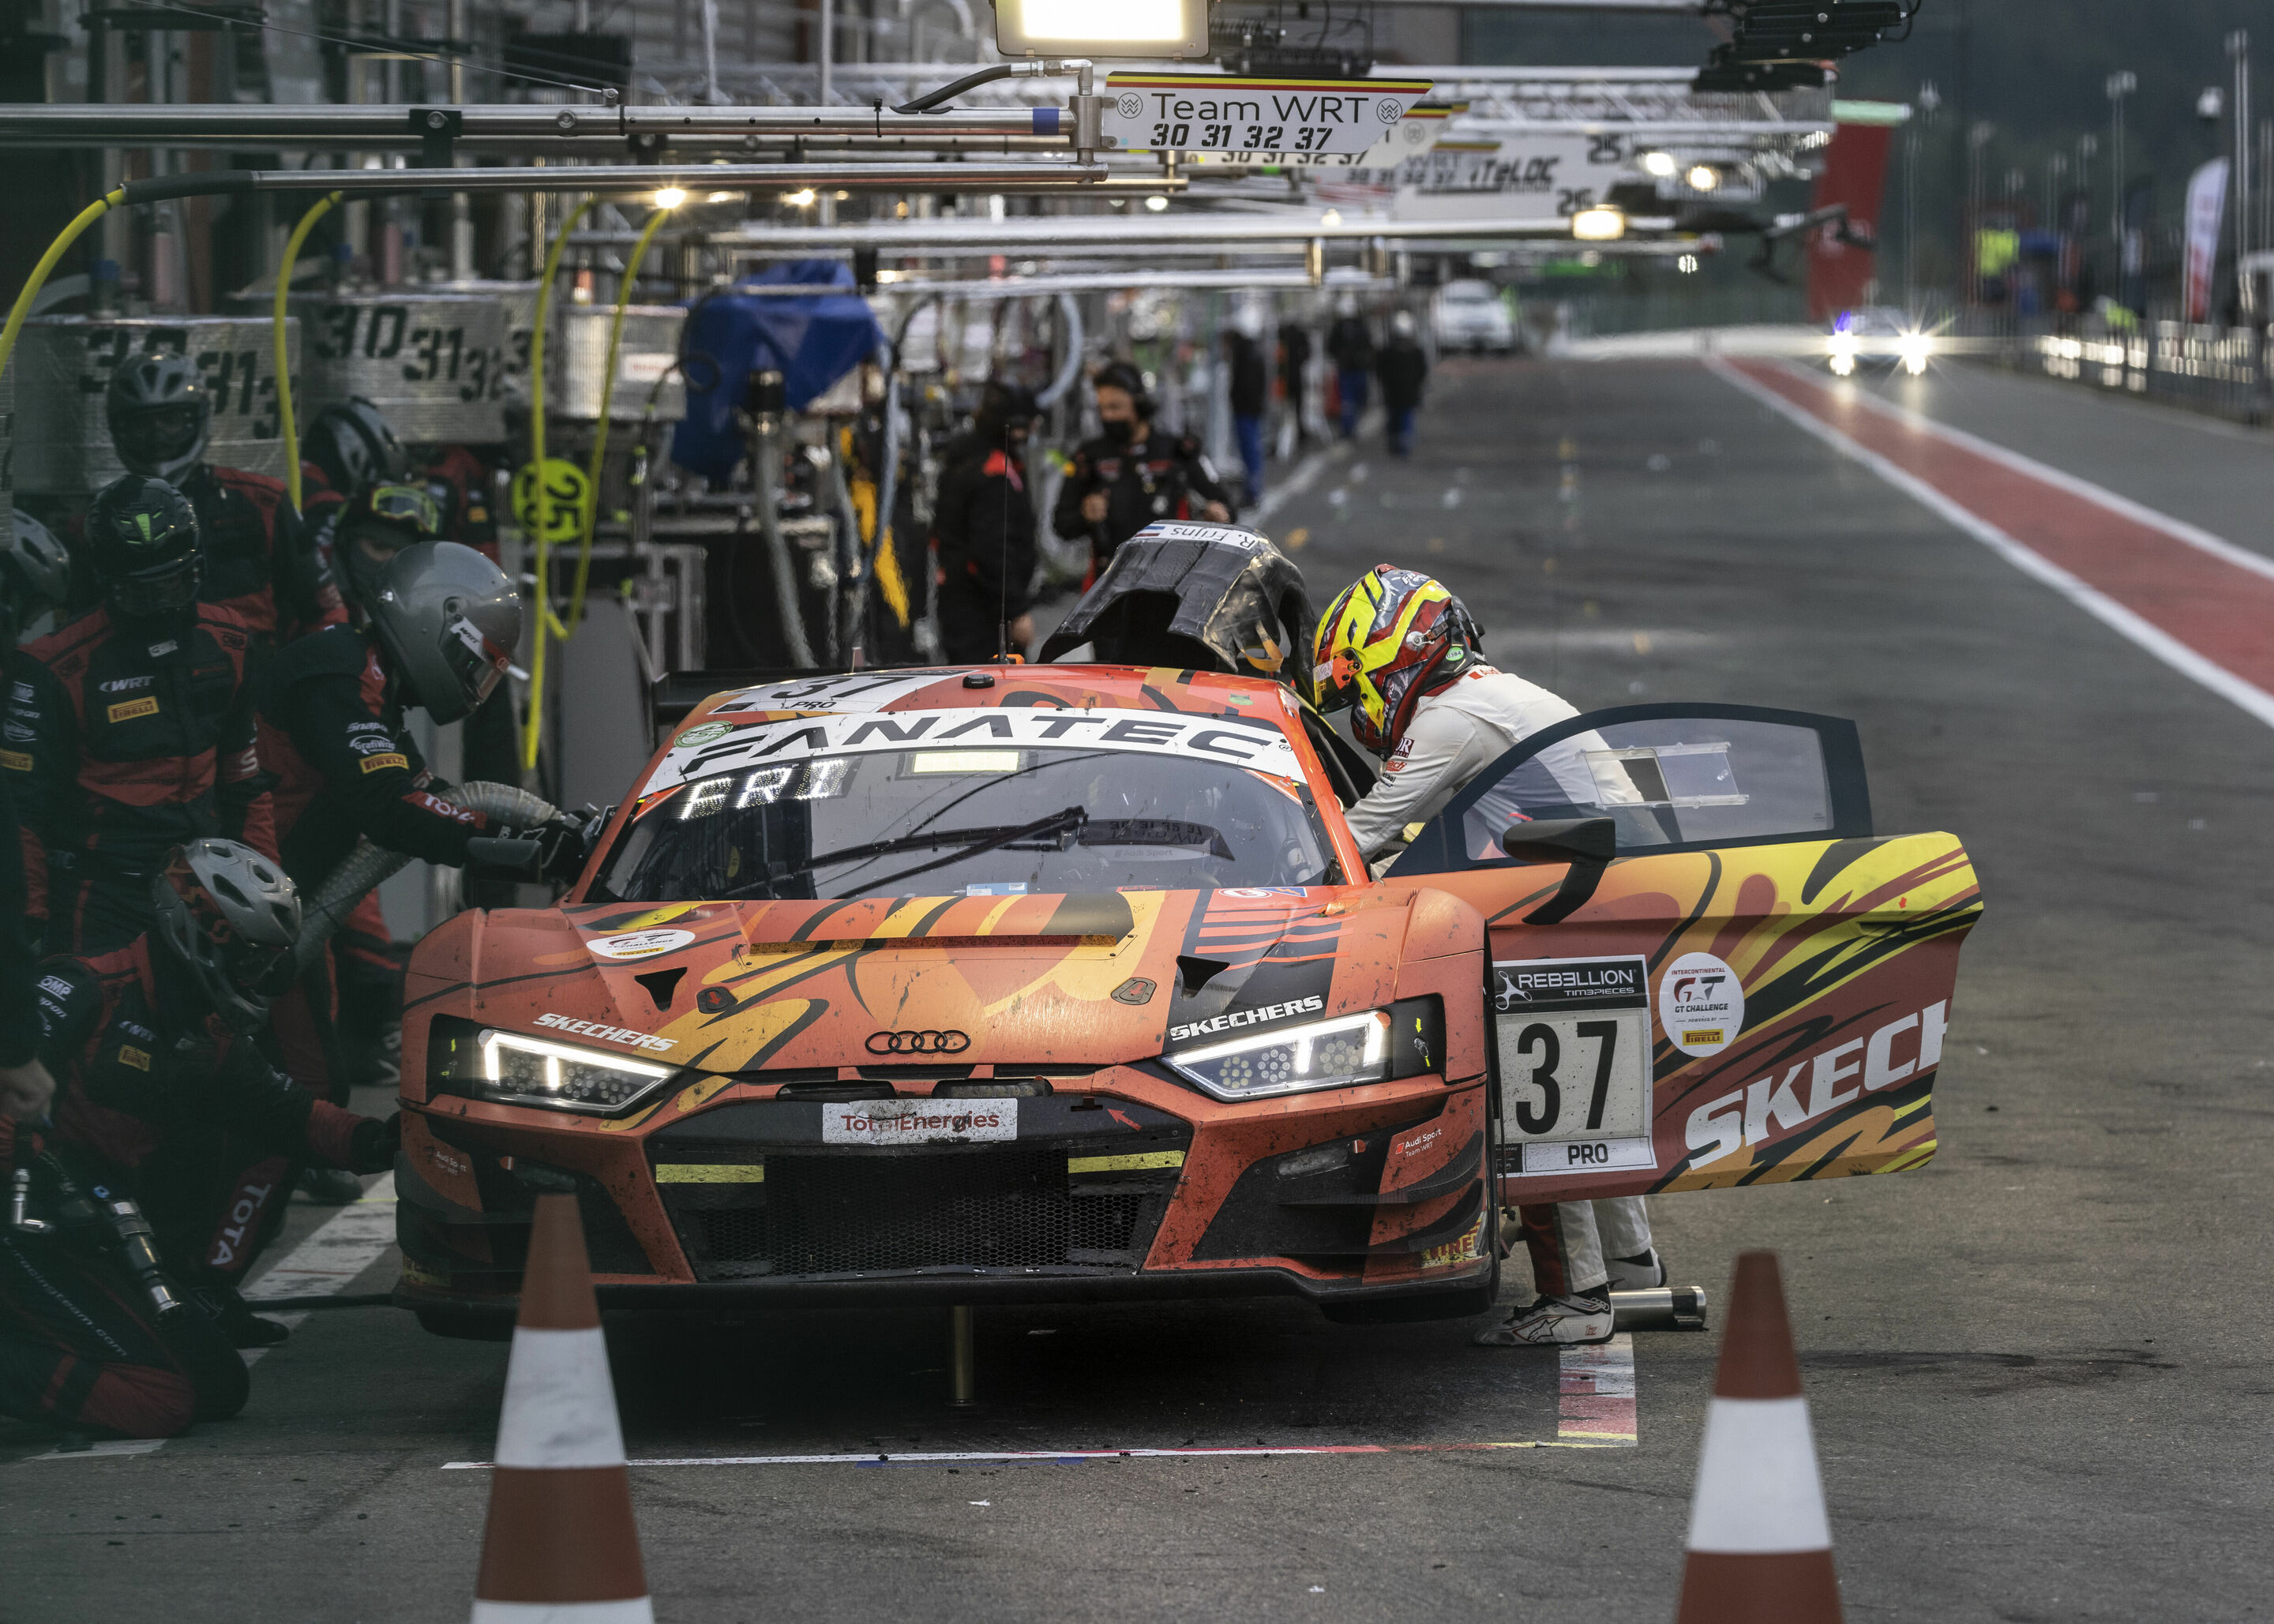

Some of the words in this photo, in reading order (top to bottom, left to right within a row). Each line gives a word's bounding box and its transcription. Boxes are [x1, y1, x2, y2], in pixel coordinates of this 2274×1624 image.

[1151, 92, 1261, 121] Team
[1271, 94, 1369, 124] WRT
[1150, 123, 1189, 147] 30
[1201, 124, 1233, 148] 31
[1244, 125, 1284, 149] 32
[1294, 127, 1334, 151] 37
[111, 676, 156, 692] WRT
[770, 676, 918, 699] 37
[789, 700, 838, 711] PRO
[679, 713, 1273, 777] FANATEC
[680, 759, 849, 821] FRI
[1518, 968, 1634, 988] REBELLION
[1671, 967, 1726, 976] INTERCONTINENTAL
[39, 977, 72, 998] OMP
[1169, 994, 1325, 1042] SKECHERS
[1675, 1005, 1686, 1014] GT
[1686, 1003, 1729, 1013] CHALLENGE
[531, 1012, 680, 1052] SKECHERS
[1685, 1030, 1721, 1044] PIRELLI
[1515, 1019, 1619, 1135] 37
[1405, 1135, 1422, 1150] Audi
[1422, 1127, 1443, 1143] Sport
[1405, 1147, 1420, 1158] Team
[1420, 1141, 1434, 1153] WRT
[1567, 1142, 1608, 1165] PRO
